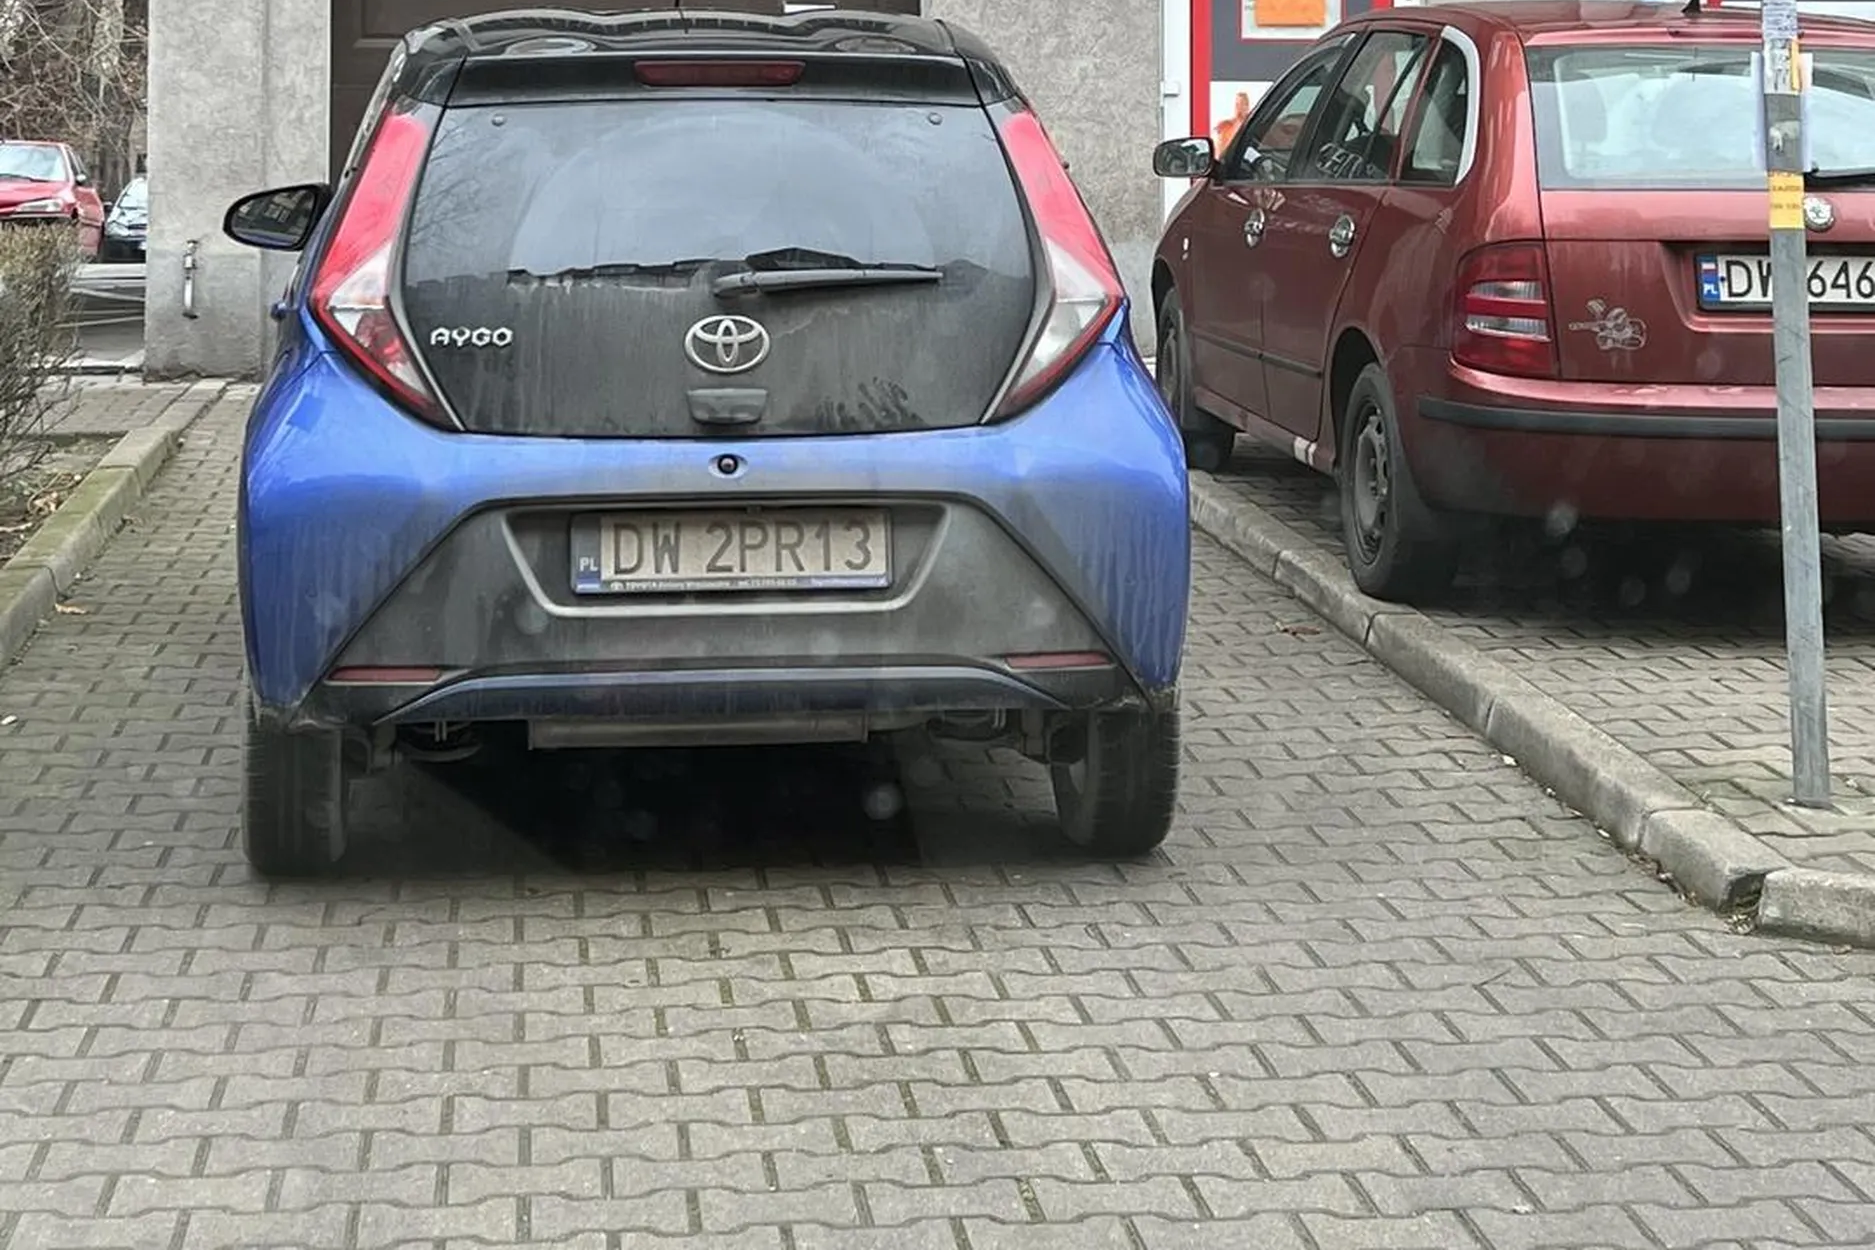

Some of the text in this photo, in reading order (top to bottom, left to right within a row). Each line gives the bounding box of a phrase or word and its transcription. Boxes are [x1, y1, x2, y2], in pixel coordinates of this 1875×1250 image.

[1703, 283, 1717, 295] PL
[430, 327, 514, 347] AYGO
[579, 519, 872, 575] PL DW 2PR13
